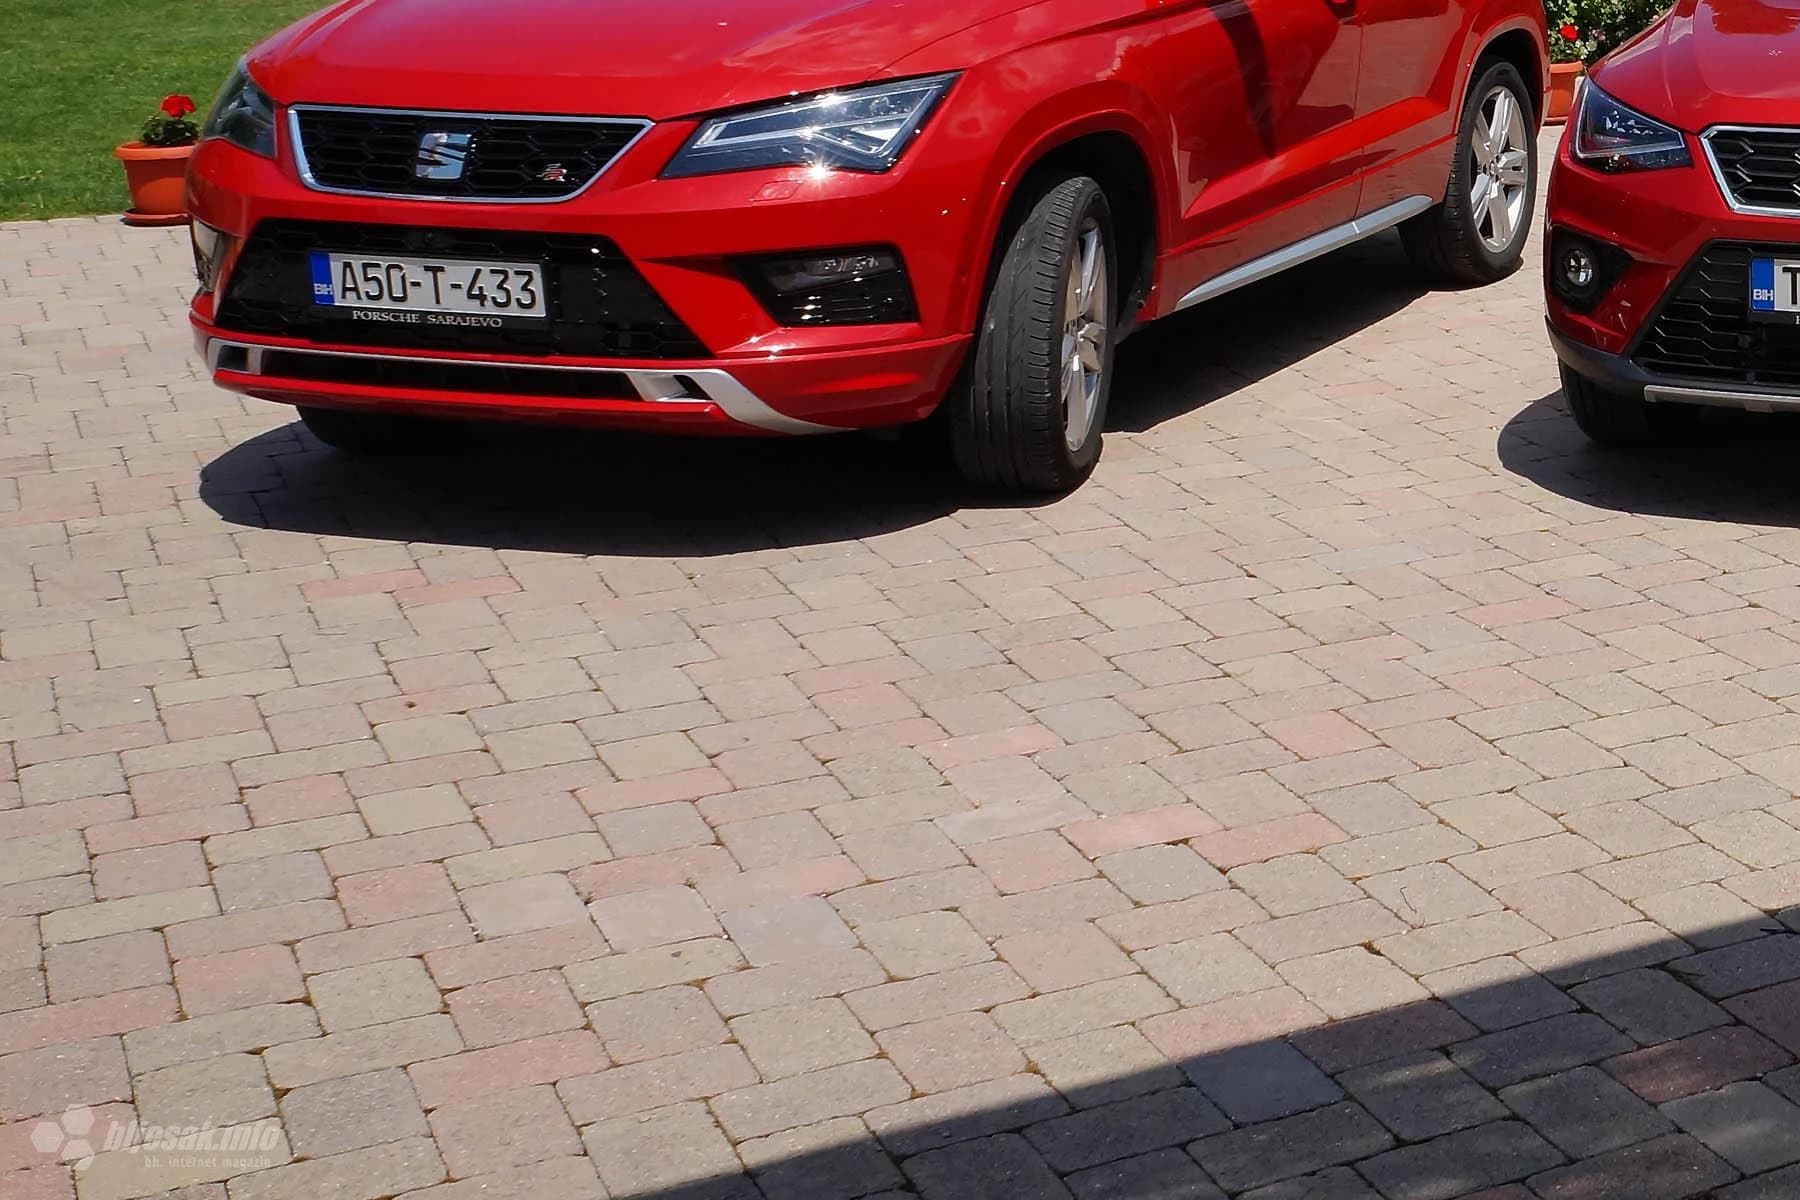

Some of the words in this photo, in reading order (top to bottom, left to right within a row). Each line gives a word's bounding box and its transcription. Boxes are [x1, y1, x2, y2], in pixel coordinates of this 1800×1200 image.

[340, 260, 538, 310] A50-T-433
[1753, 288, 1774, 301] BIH
[352, 309, 422, 324] PORSCHE
[426, 313, 503, 328] SARAJEVO
